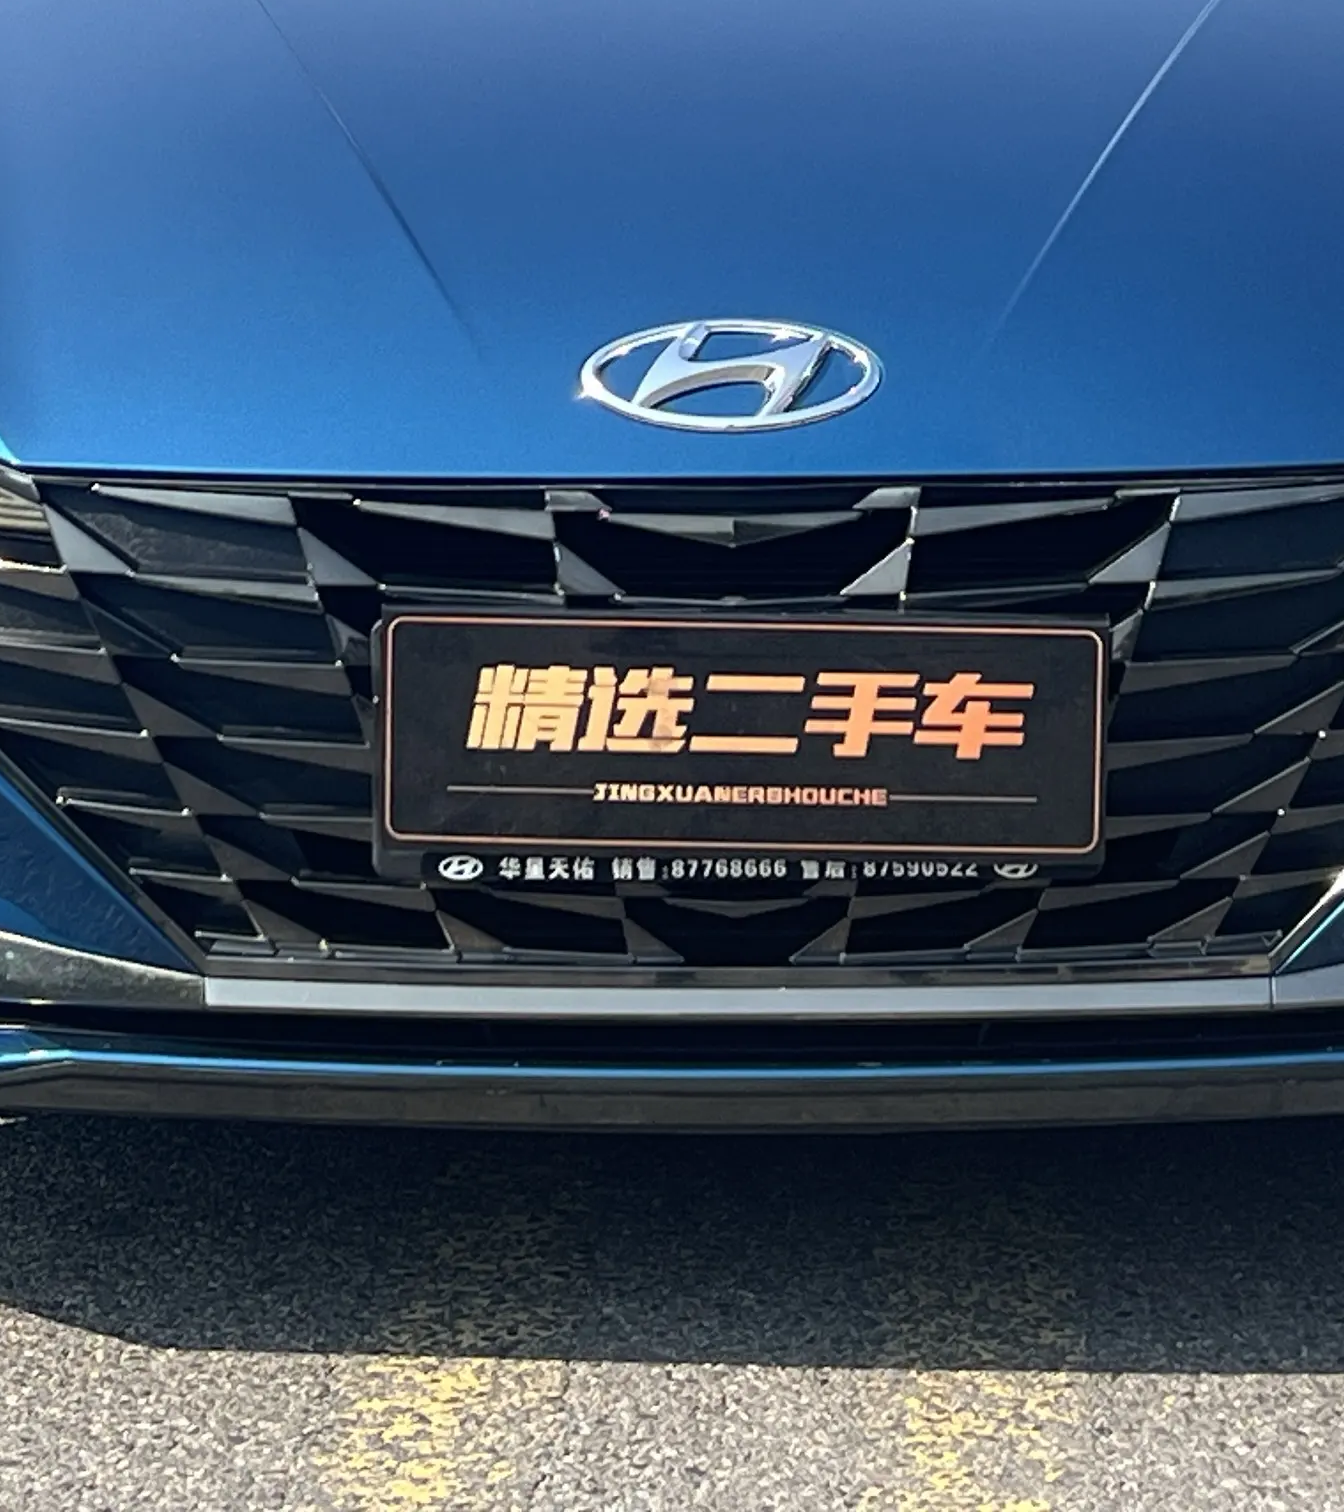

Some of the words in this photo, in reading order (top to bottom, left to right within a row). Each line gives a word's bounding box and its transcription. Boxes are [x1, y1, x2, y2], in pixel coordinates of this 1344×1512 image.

[467, 664, 1034, 759] 精选二手车
[593, 783, 887, 806] JINGXUANERSHOUCHE
